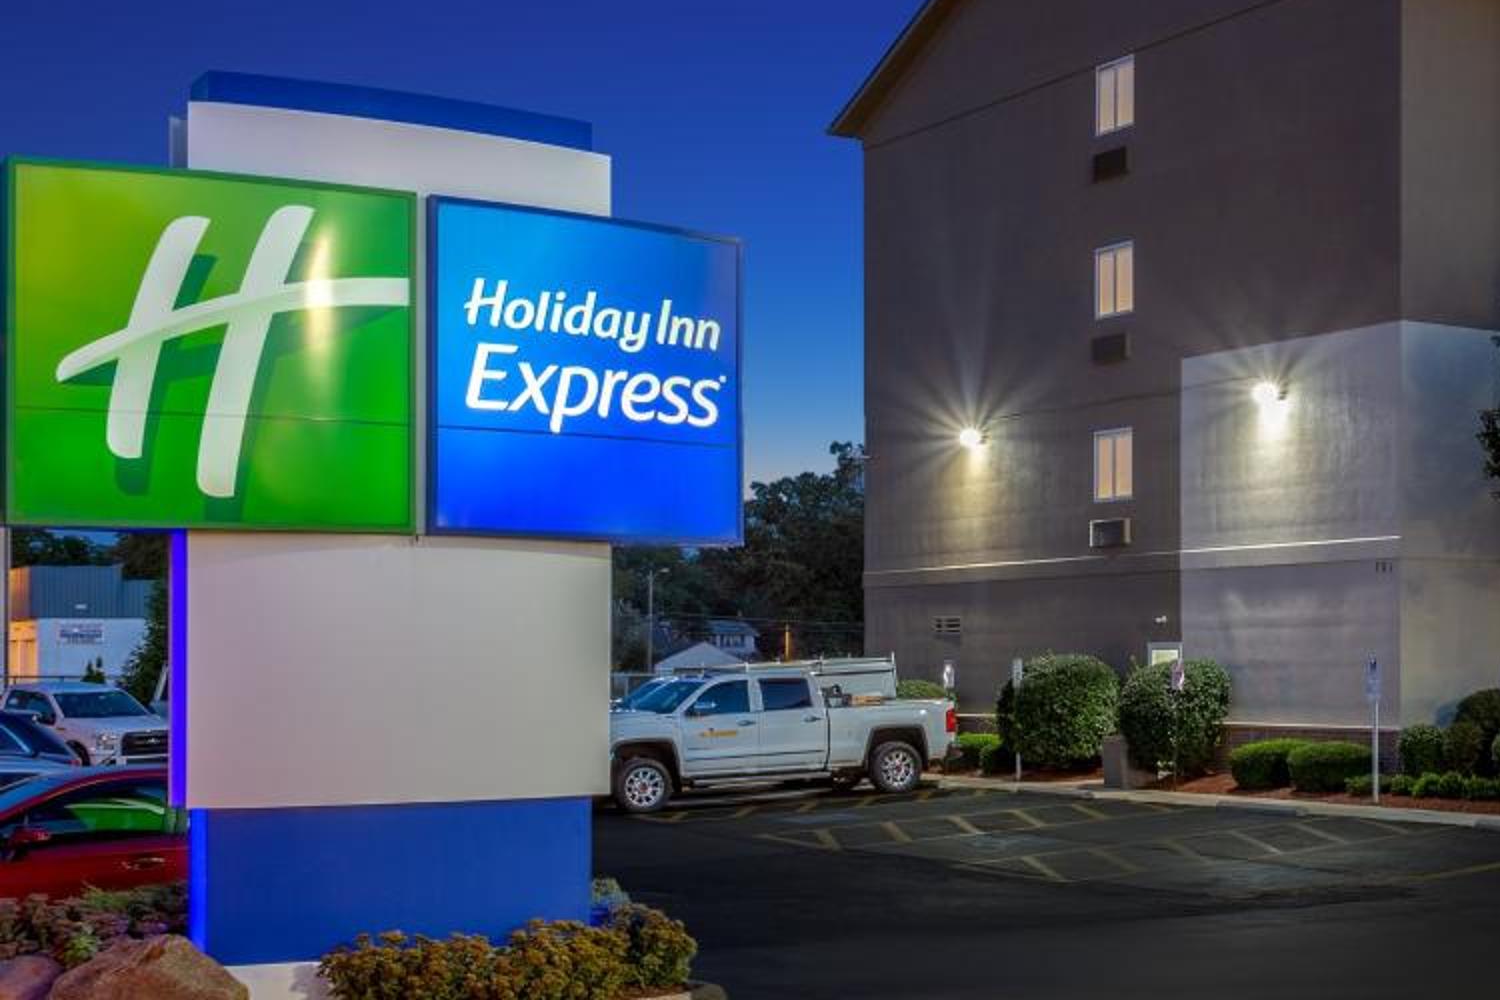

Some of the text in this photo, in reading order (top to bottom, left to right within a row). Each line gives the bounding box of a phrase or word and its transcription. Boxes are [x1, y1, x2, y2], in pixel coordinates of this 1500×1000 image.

[463, 276, 721, 353] Holiday Inn
[464, 341, 721, 434] Express
